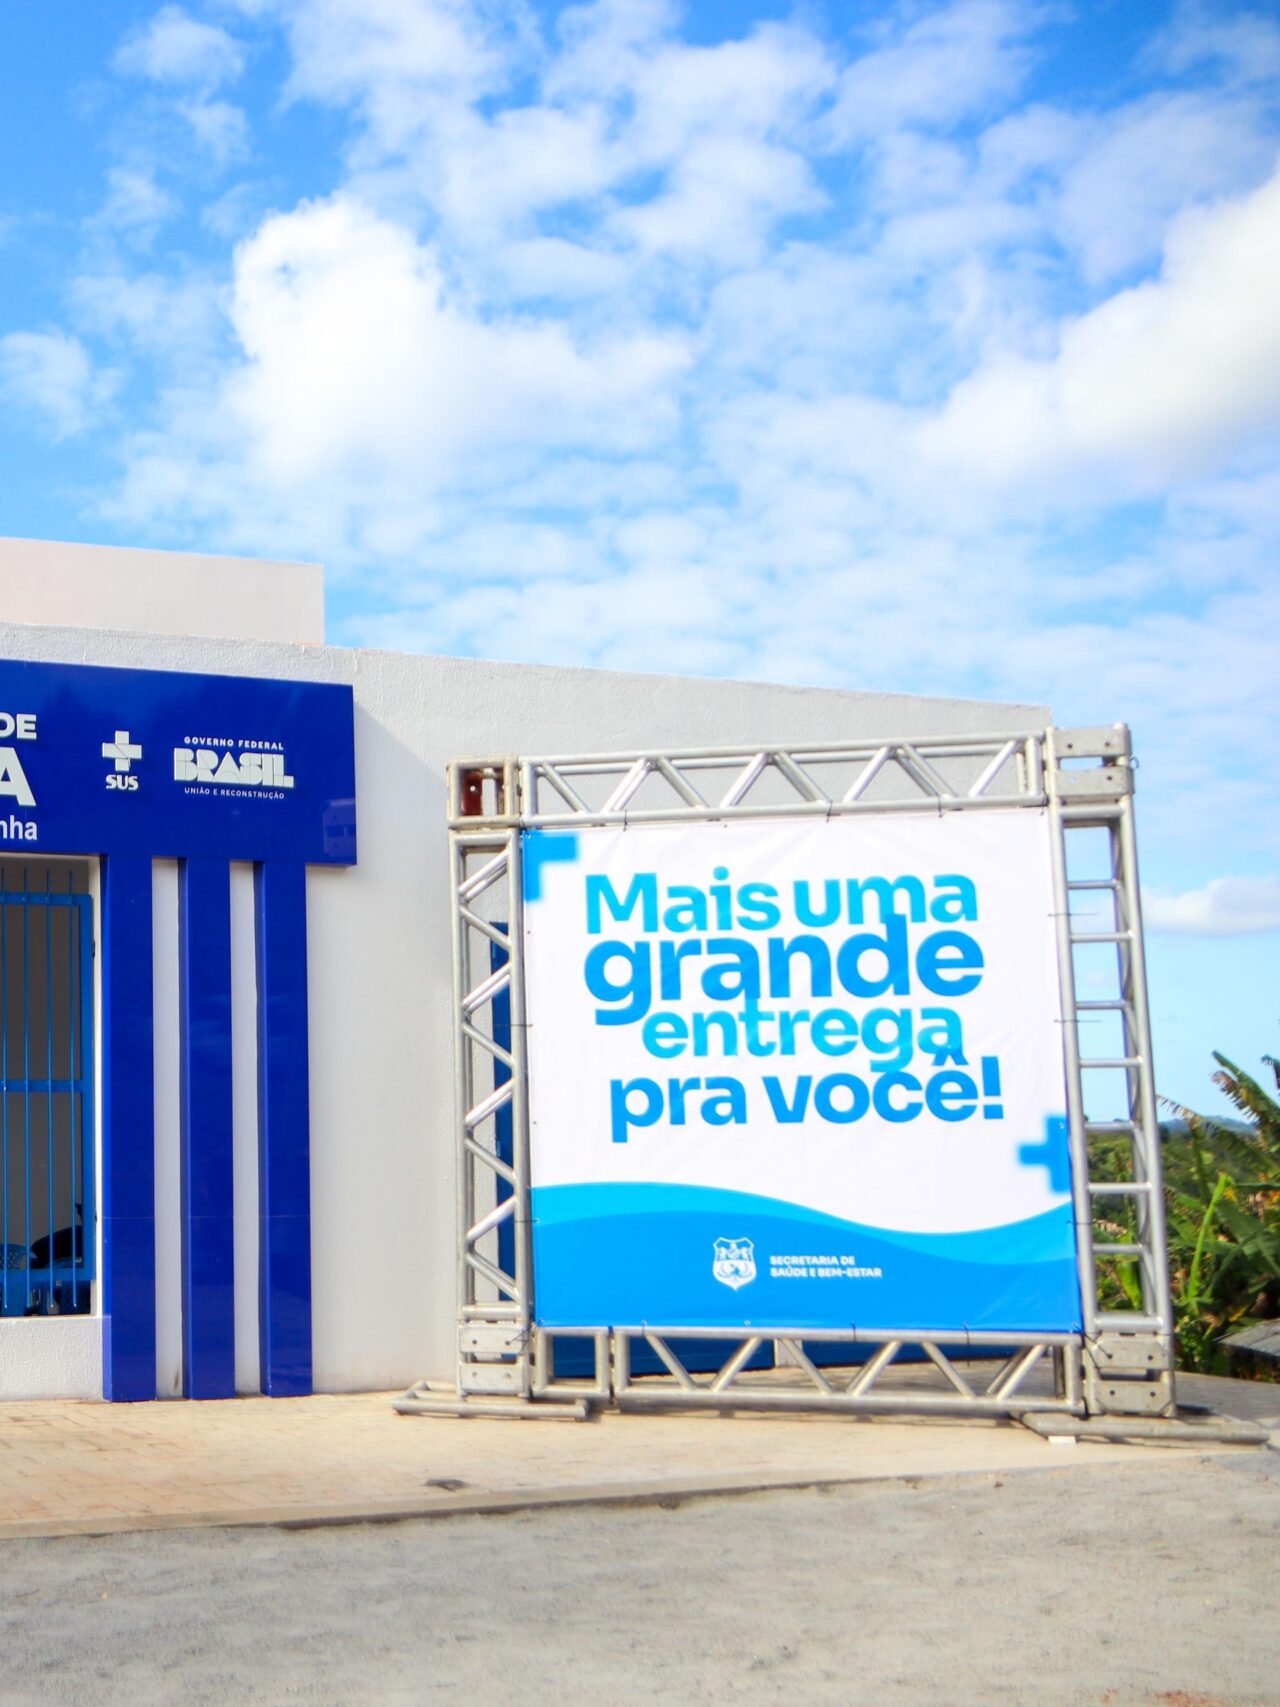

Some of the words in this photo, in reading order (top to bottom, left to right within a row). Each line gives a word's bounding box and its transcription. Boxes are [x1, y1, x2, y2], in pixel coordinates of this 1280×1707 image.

[184, 736, 234, 747] GOVERNO
[238, 740, 284, 750] FEDERAL
[174, 748, 294, 788] BRASIL
[105, 774, 139, 791] SUS
[184, 787, 210, 795] UNIÃO
[213, 788, 218, 796] E
[220, 789, 285, 799] RECONSTRUÇÃO
[585, 866, 781, 934] Mais
[793, 874, 978, 927] uma
[584, 914, 984, 1026] grande
[642, 998, 963, 1072] entrega
[610, 1076, 747, 1143] pra
[762, 1050, 1004, 1124] você!
[769, 1256, 839, 1265] SECRETARIA
[840, 1256, 855, 1265] DE
[770, 1266, 807, 1277] SAÚDE
[809, 1268, 816, 1277] E
[818, 1268, 882, 1277] BEM-ESTAR
